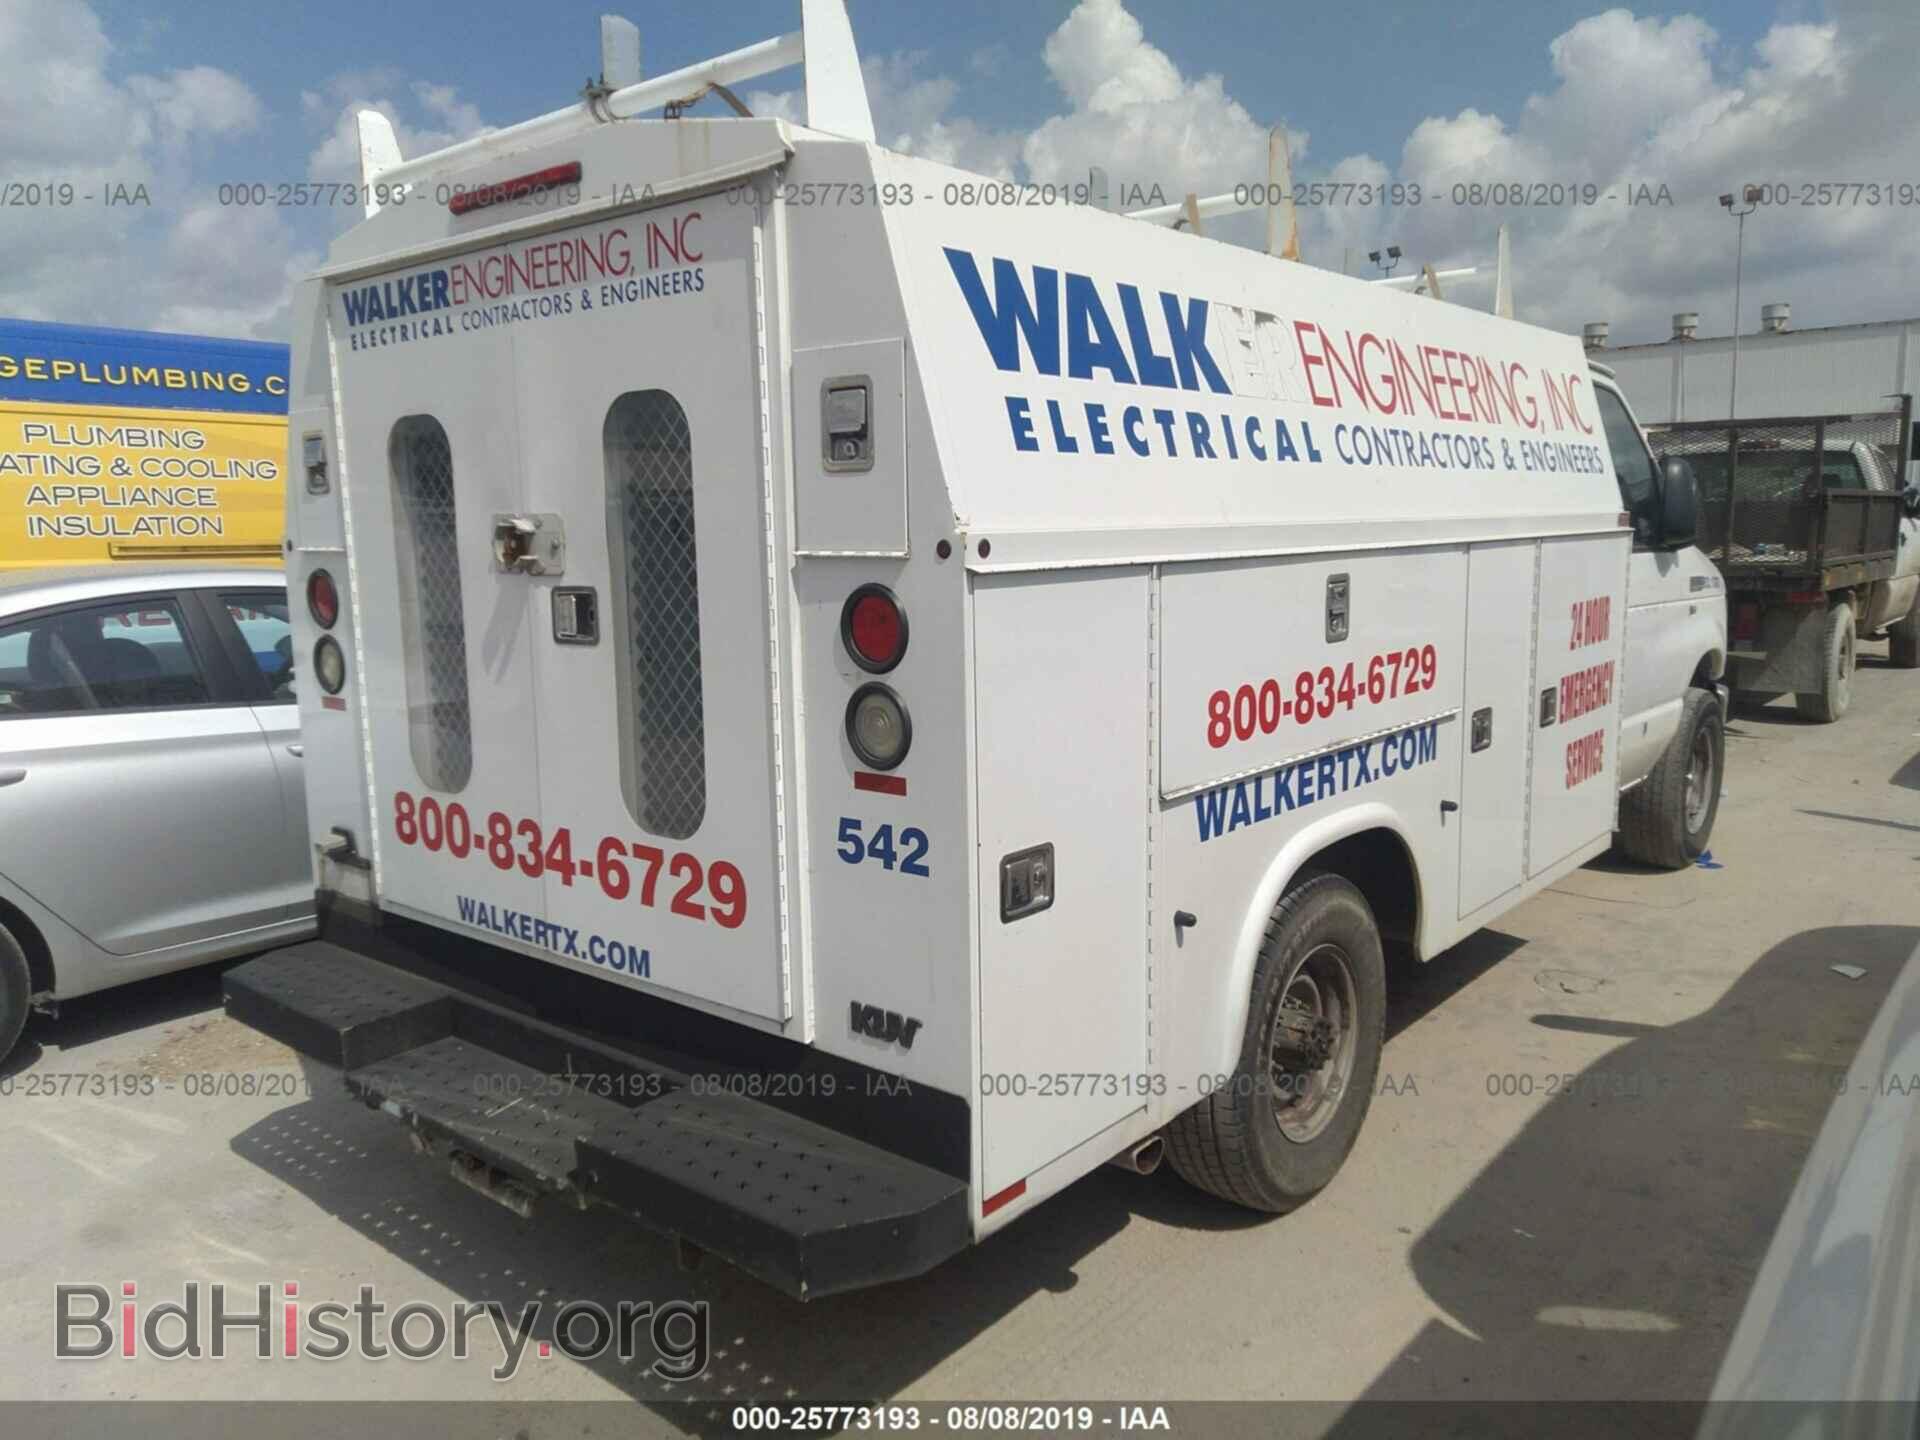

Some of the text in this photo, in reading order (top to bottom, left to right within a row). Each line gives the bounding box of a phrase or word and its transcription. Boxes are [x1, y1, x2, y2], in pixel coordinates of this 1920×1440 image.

[646, 212, 703, 269] INC
[351, 267, 705, 351] ELECTRICAL CONTRACTORS & ENGINEERS
[1541, 368, 1593, 435] INC
[24, 423, 206, 450] PLUMBING
[1004, 396, 1605, 474] ELECTRICAL CONTRACTORS & ENGINEERS
[0, 454, 278, 480] ATING & COOLING
[27, 486, 217, 507] APPLIANCE
[28, 516, 223, 537] INSULATION
[1207, 643, 1437, 750] 800-834-6729
[1194, 722, 1438, 843] WALKERTX.COM
[1565, 728, 1604, 790] SERVICE
[394, 791, 748, 930] 800-834-6729
[837, 816, 931, 878] 542
[457, 894, 652, 979] WALKERTX.COM
[850, 1000, 923, 1050] KUV
